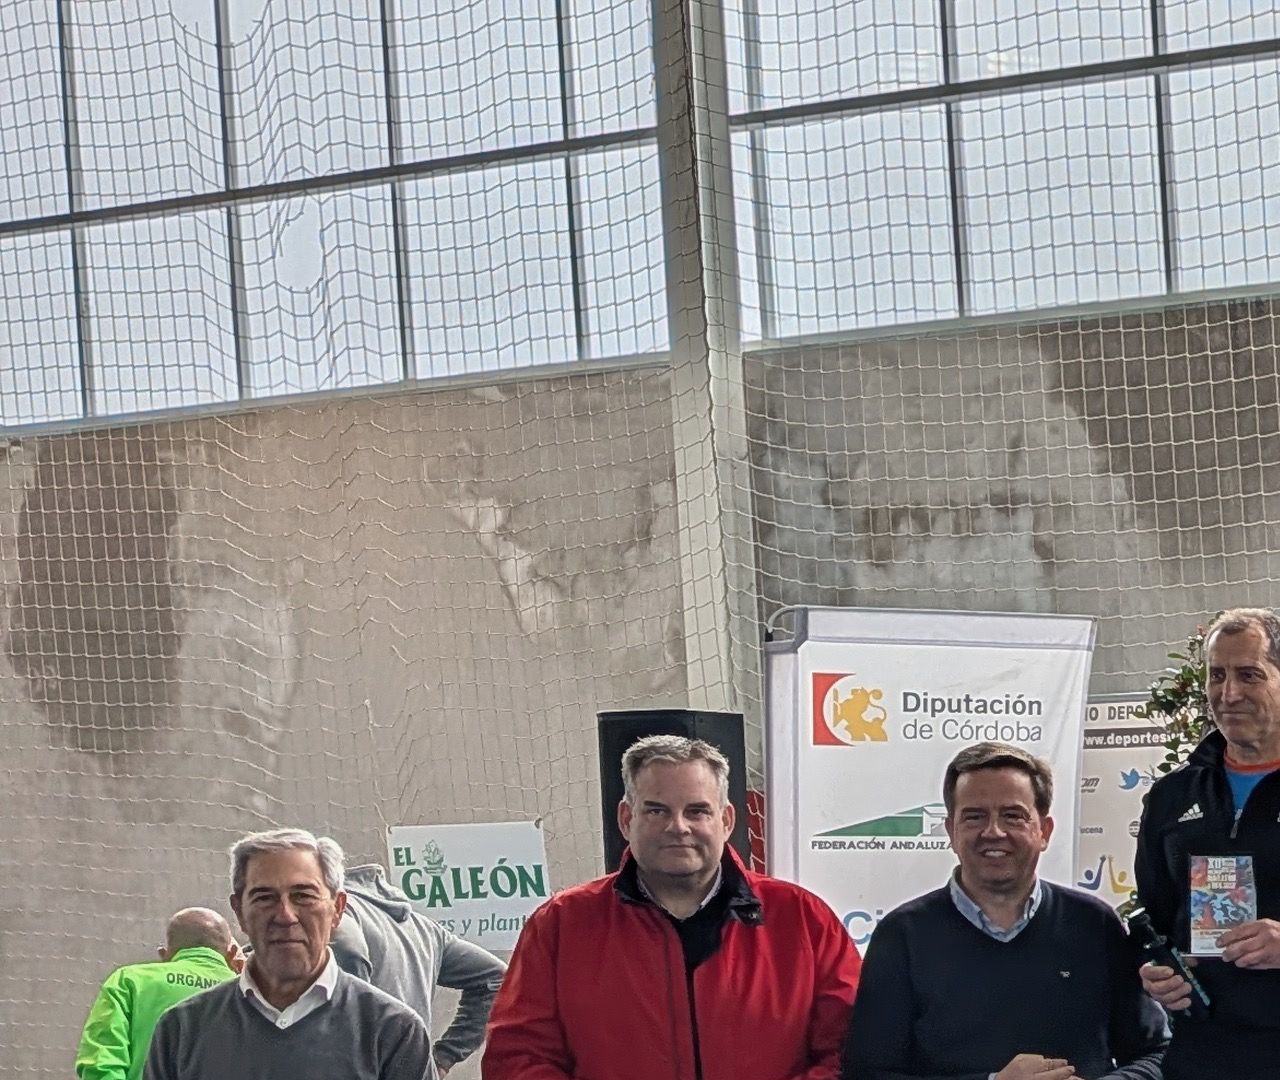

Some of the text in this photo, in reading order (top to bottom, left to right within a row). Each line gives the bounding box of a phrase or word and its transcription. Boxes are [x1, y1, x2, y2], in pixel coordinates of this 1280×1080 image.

[902, 692, 1042, 718] Diputación
[902, 718, 1042, 741] de Córdoba
[811, 837, 886, 850] FEDERACIÓN
[393, 847, 416, 866] EL
[402, 858, 547, 907] GALEÓN
[460, 917, 472, 936] y
